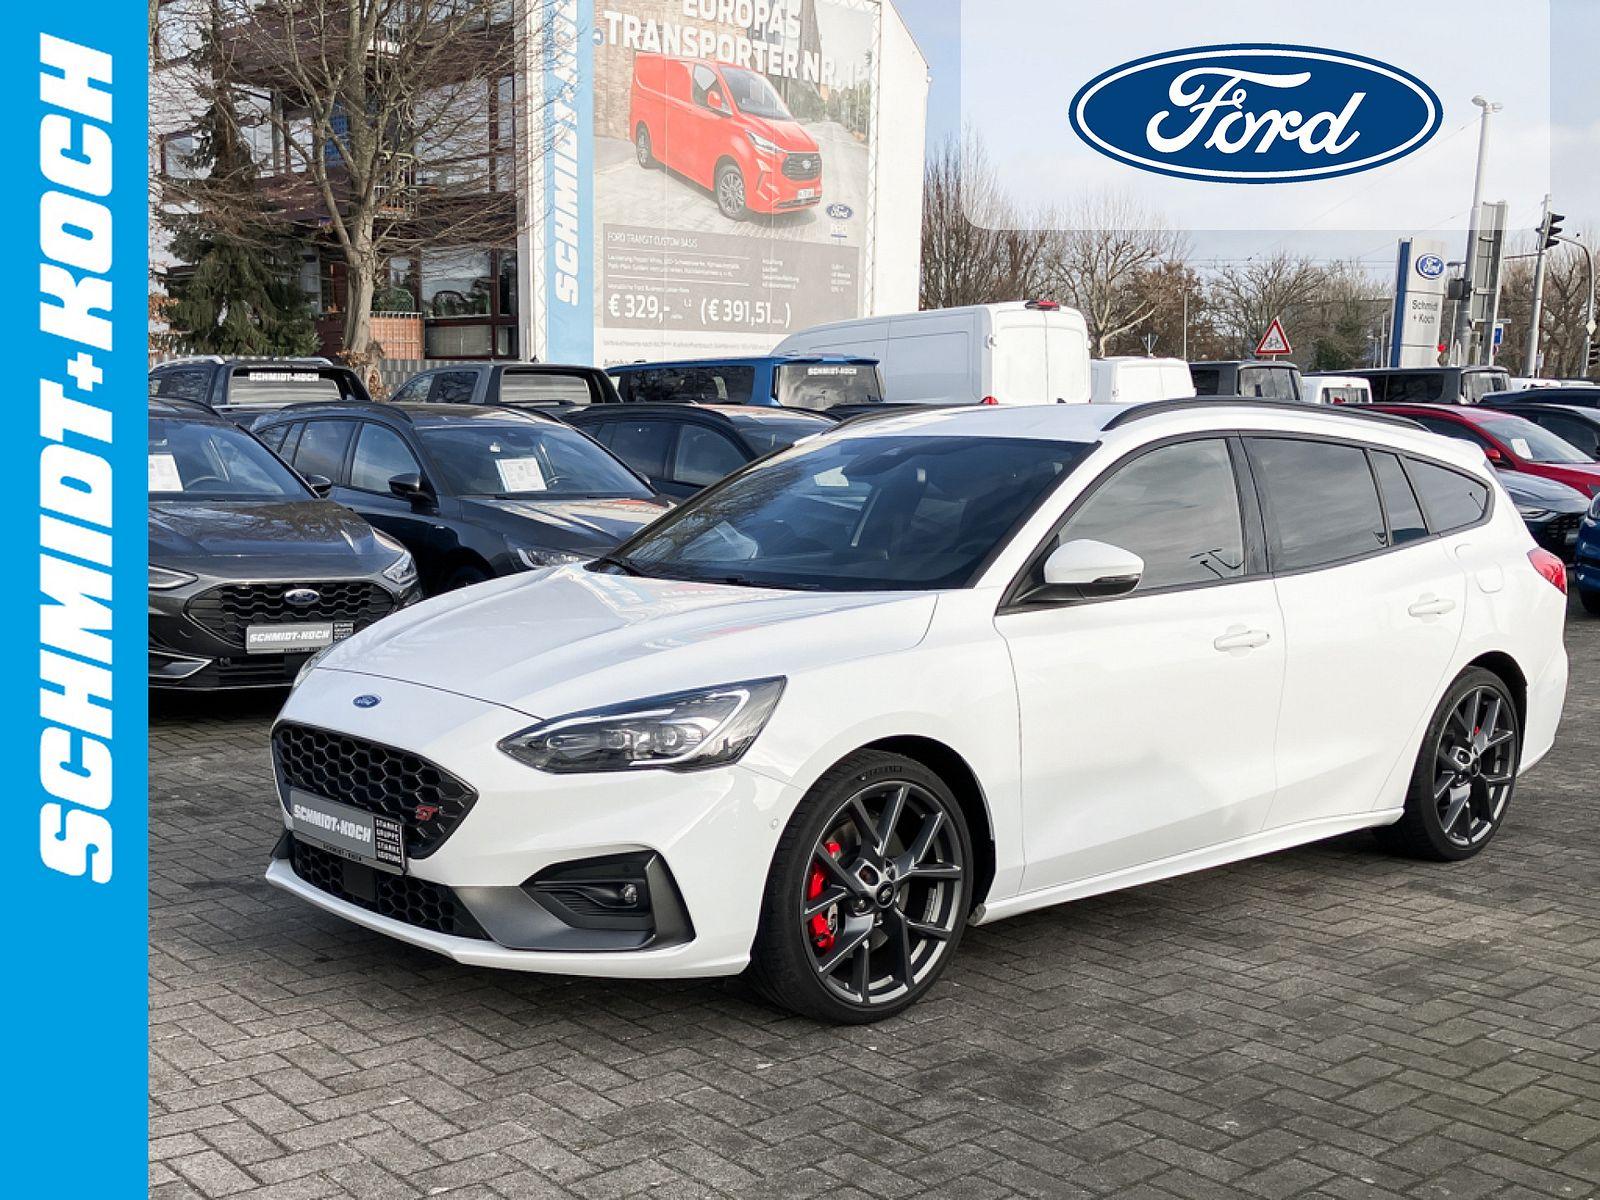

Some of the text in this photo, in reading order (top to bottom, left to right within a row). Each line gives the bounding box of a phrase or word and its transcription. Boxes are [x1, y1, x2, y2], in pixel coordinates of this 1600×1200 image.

[683, 0, 802, 38] EUROPAS
[604, 11, 799, 78] TRANSPORTER
[608, 294, 622, 318] €
[624, 296, 671, 323] 329,-
